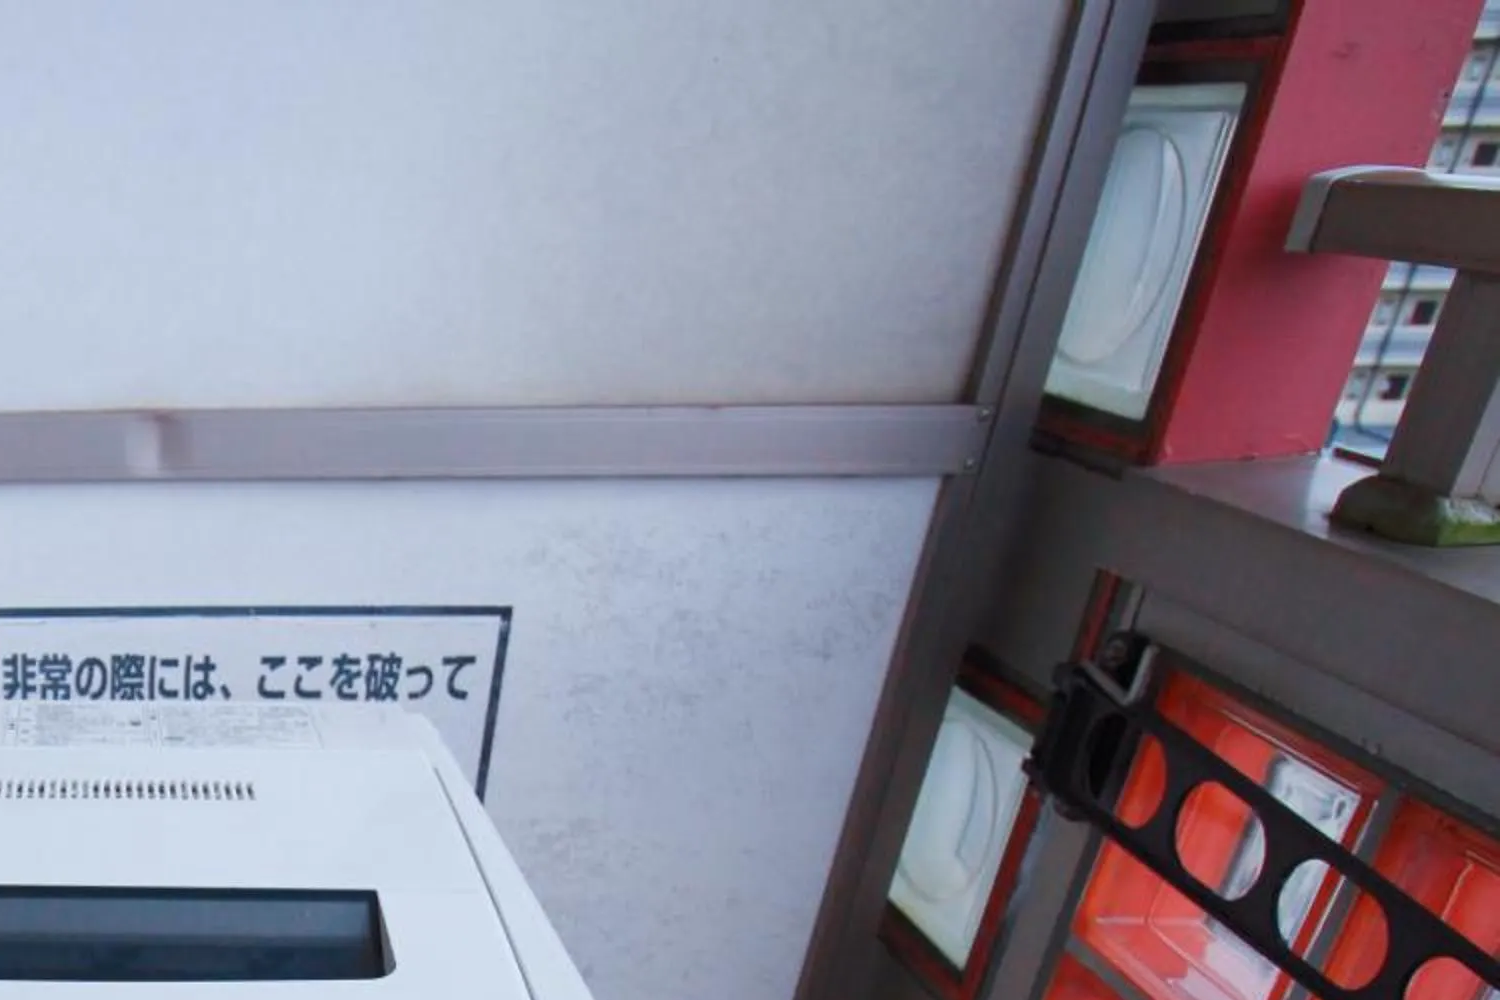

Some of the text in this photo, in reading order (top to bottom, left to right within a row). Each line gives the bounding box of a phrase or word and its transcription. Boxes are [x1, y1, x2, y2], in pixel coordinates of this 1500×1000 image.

[2, 652, 477, 702] 非常の際には、ここを破って
